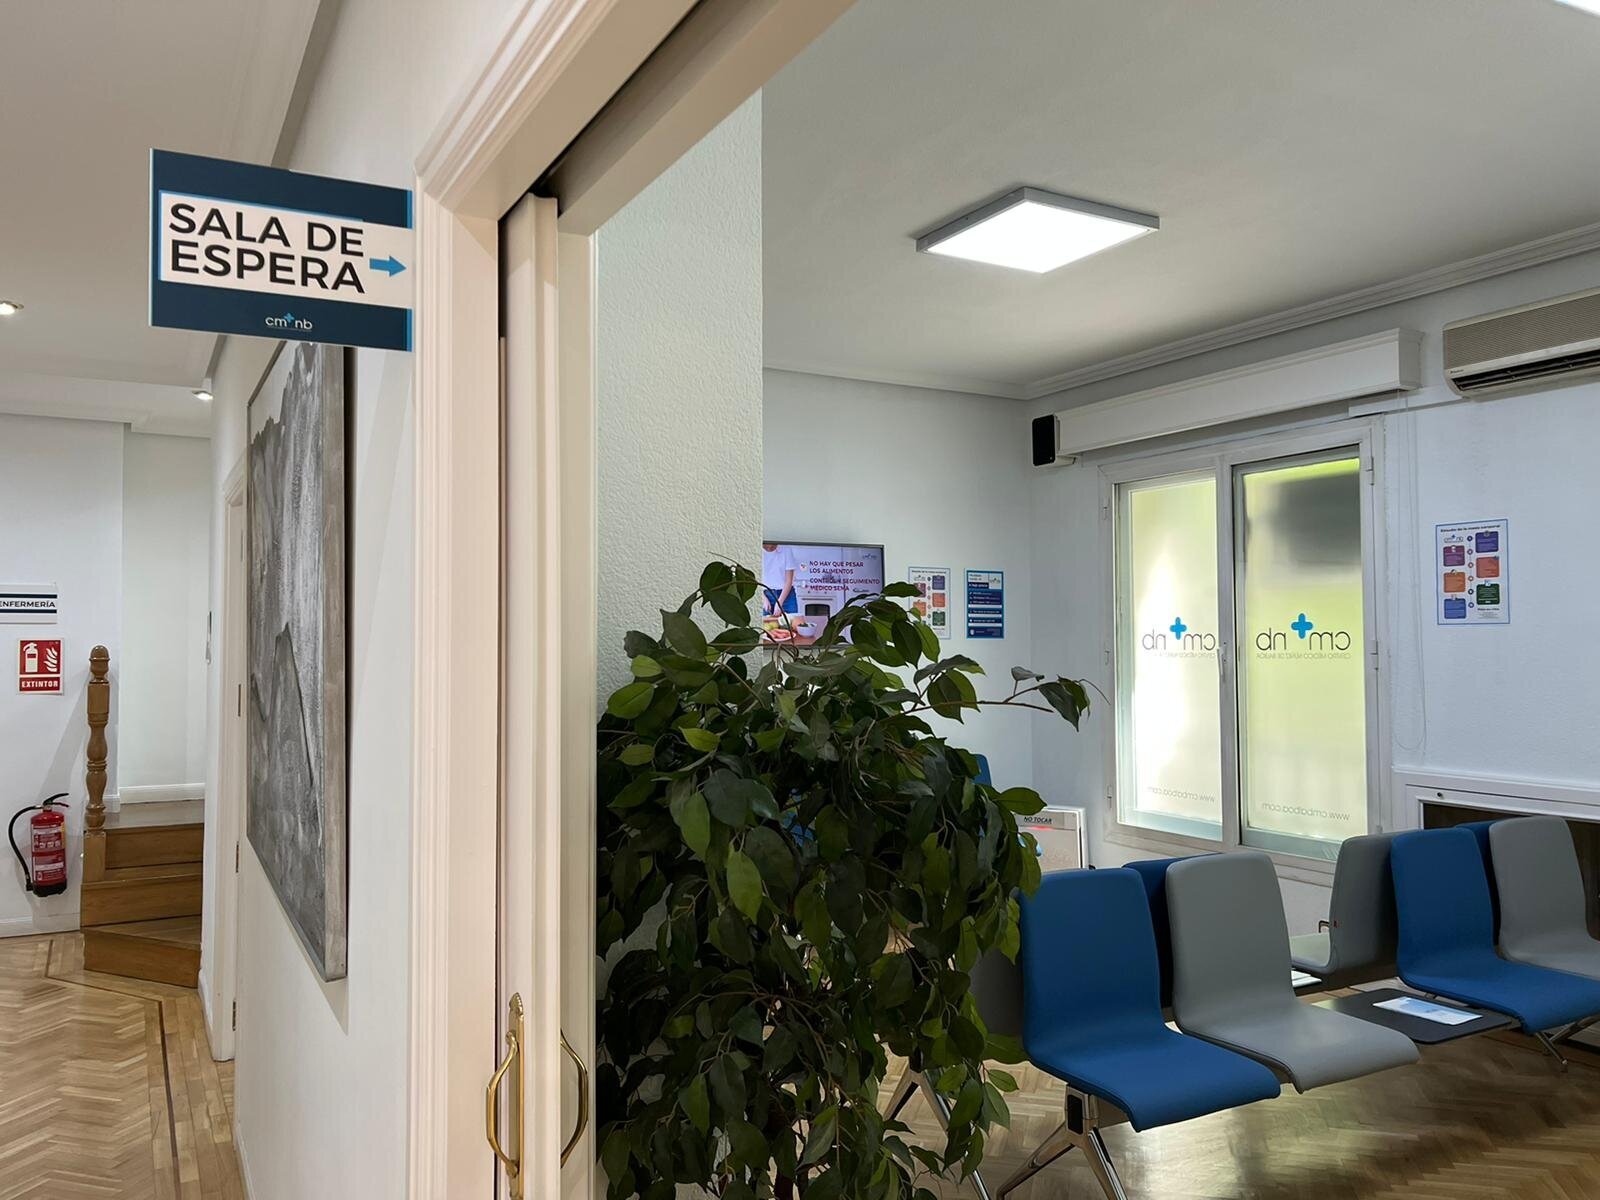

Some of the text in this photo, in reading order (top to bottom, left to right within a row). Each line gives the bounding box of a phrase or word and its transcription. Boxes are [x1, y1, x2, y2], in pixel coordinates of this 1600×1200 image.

[168, 203, 365, 258] SALA DE
[170, 239, 366, 294] ESPERA
[21, 680, 58, 688] EXTINTOR
